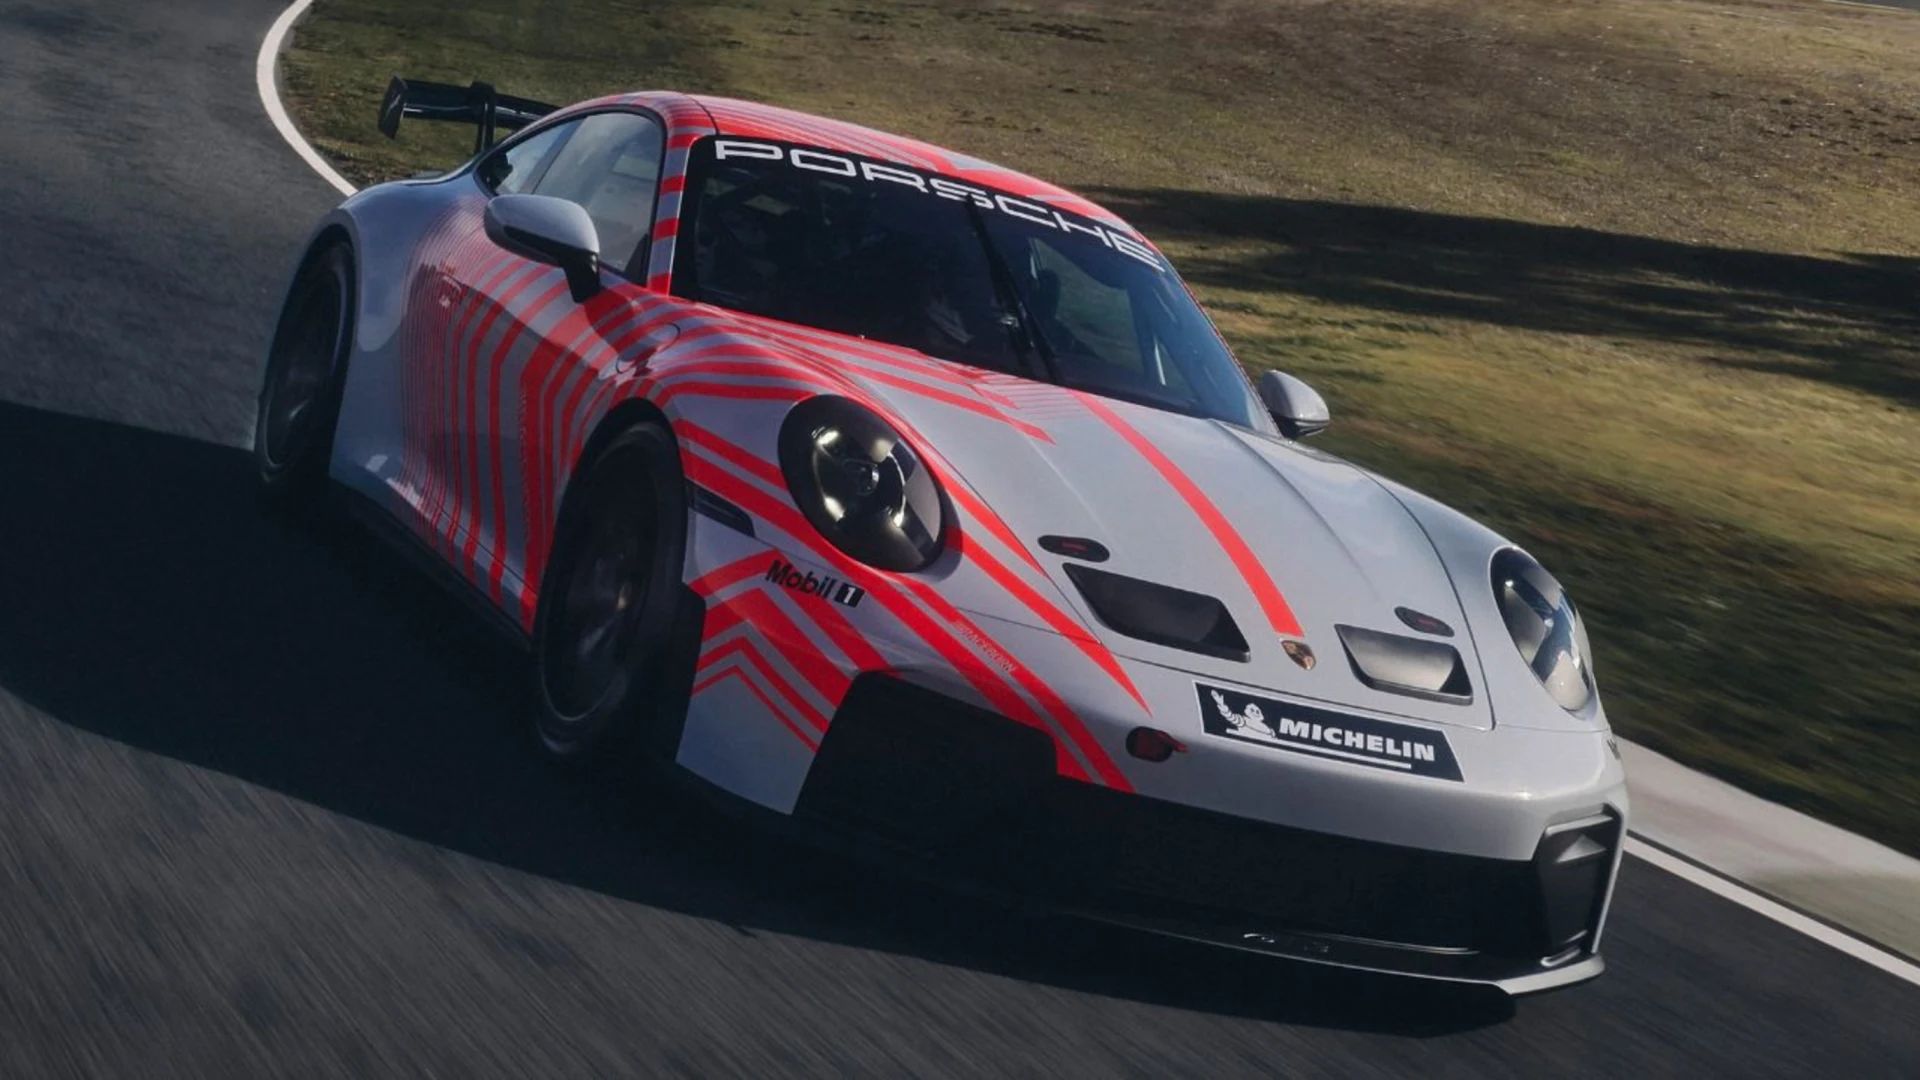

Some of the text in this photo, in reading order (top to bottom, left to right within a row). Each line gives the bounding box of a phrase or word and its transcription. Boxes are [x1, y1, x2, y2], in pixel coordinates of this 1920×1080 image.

[714, 140, 1166, 272] PORSCHE
[765, 560, 837, 598] Mobil
[1279, 717, 1435, 762] MICHELIN
